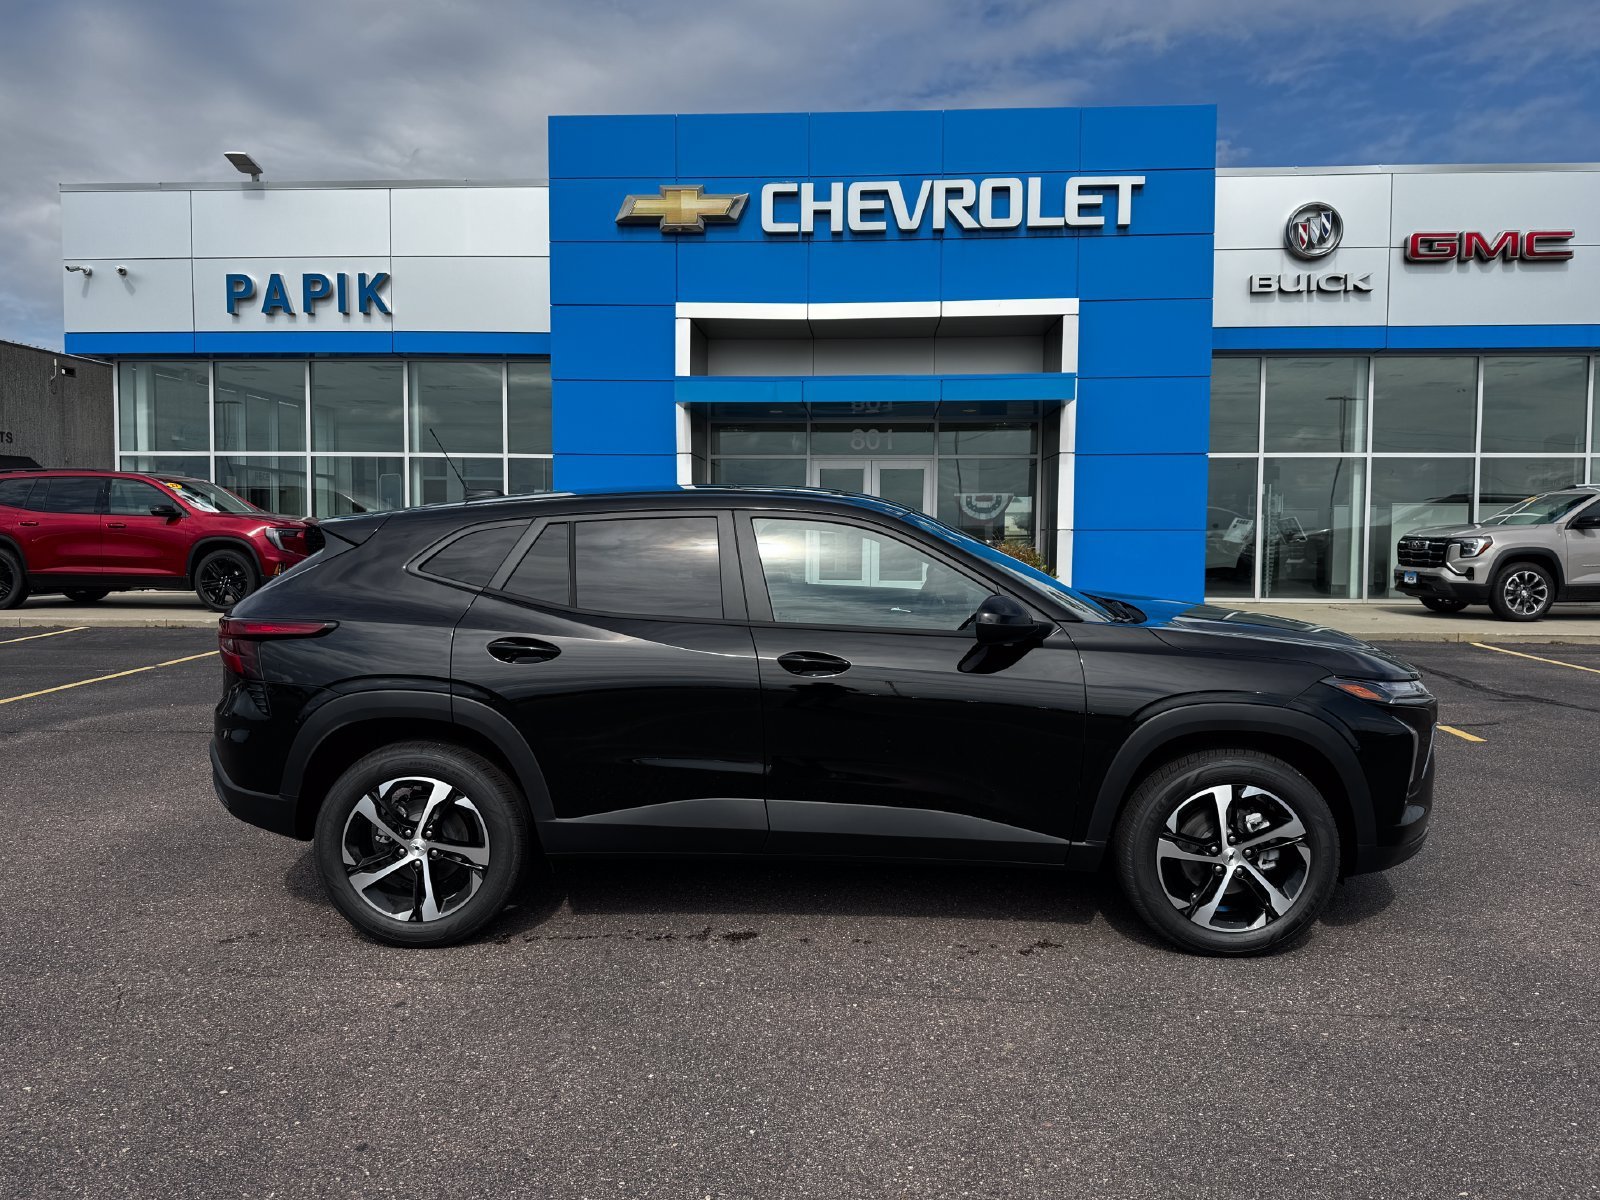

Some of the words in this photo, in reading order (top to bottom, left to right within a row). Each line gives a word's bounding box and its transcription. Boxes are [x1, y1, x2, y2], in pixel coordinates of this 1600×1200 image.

[761, 175, 1146, 234] CHEVROLET
[1405, 229, 1575, 263] GMC
[225, 272, 393, 316] PAPIK
[1249, 272, 1374, 294] BUICK
[850, 428, 893, 450] 801
